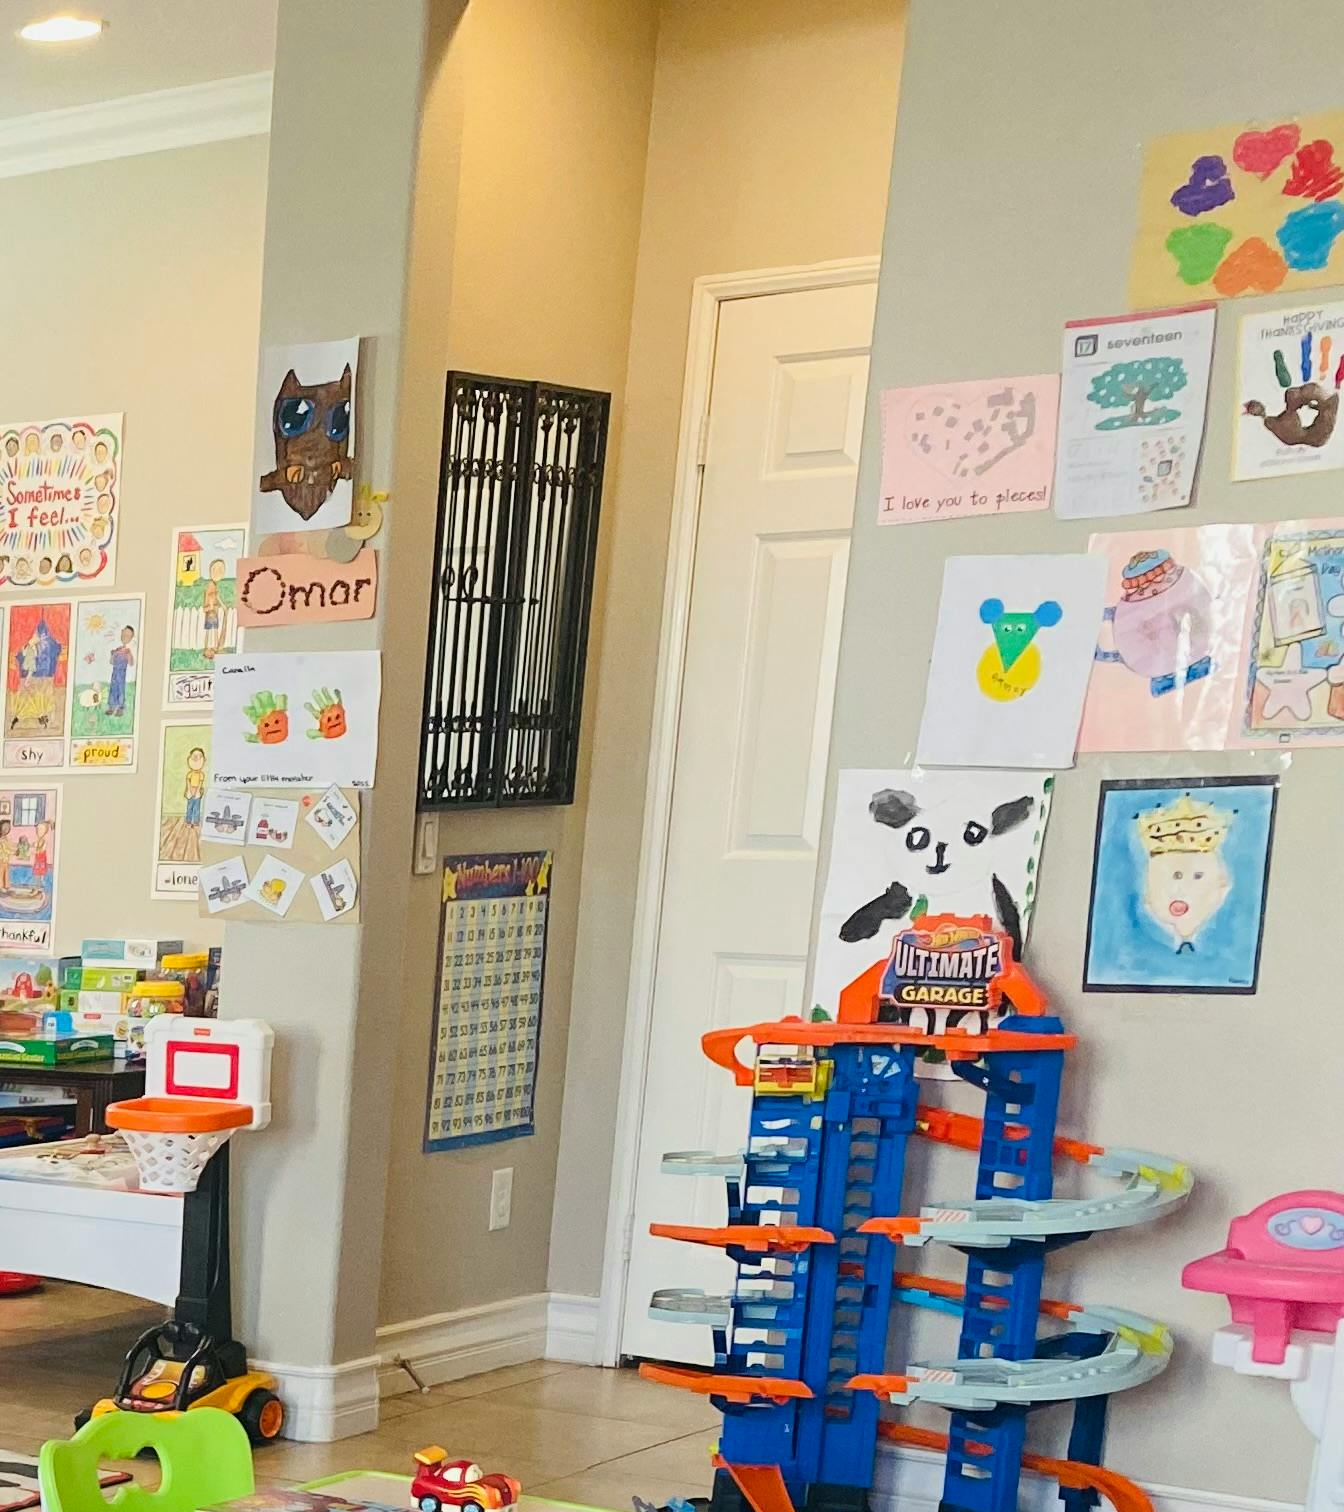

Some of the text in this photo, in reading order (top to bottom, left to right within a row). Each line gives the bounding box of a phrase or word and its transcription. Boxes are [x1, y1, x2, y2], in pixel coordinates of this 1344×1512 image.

[1107, 330, 1183, 350] seventeen
[6, 480, 82, 507] Sometimes
[883, 496, 895, 512] I
[902, 493, 931, 510] love
[936, 494, 963, 513] you
[971, 490, 989, 507] to
[8, 509, 18, 529] I
[242, 566, 372, 615] Omar
[21, 748, 44, 762] shy
[83, 746, 120, 763] proud
[214, 773, 237, 783] From
[456, 860, 511, 888] Numbers
[895, 941, 1000, 979] ULTIMATE
[902, 985, 983, 1003] GARAGE
